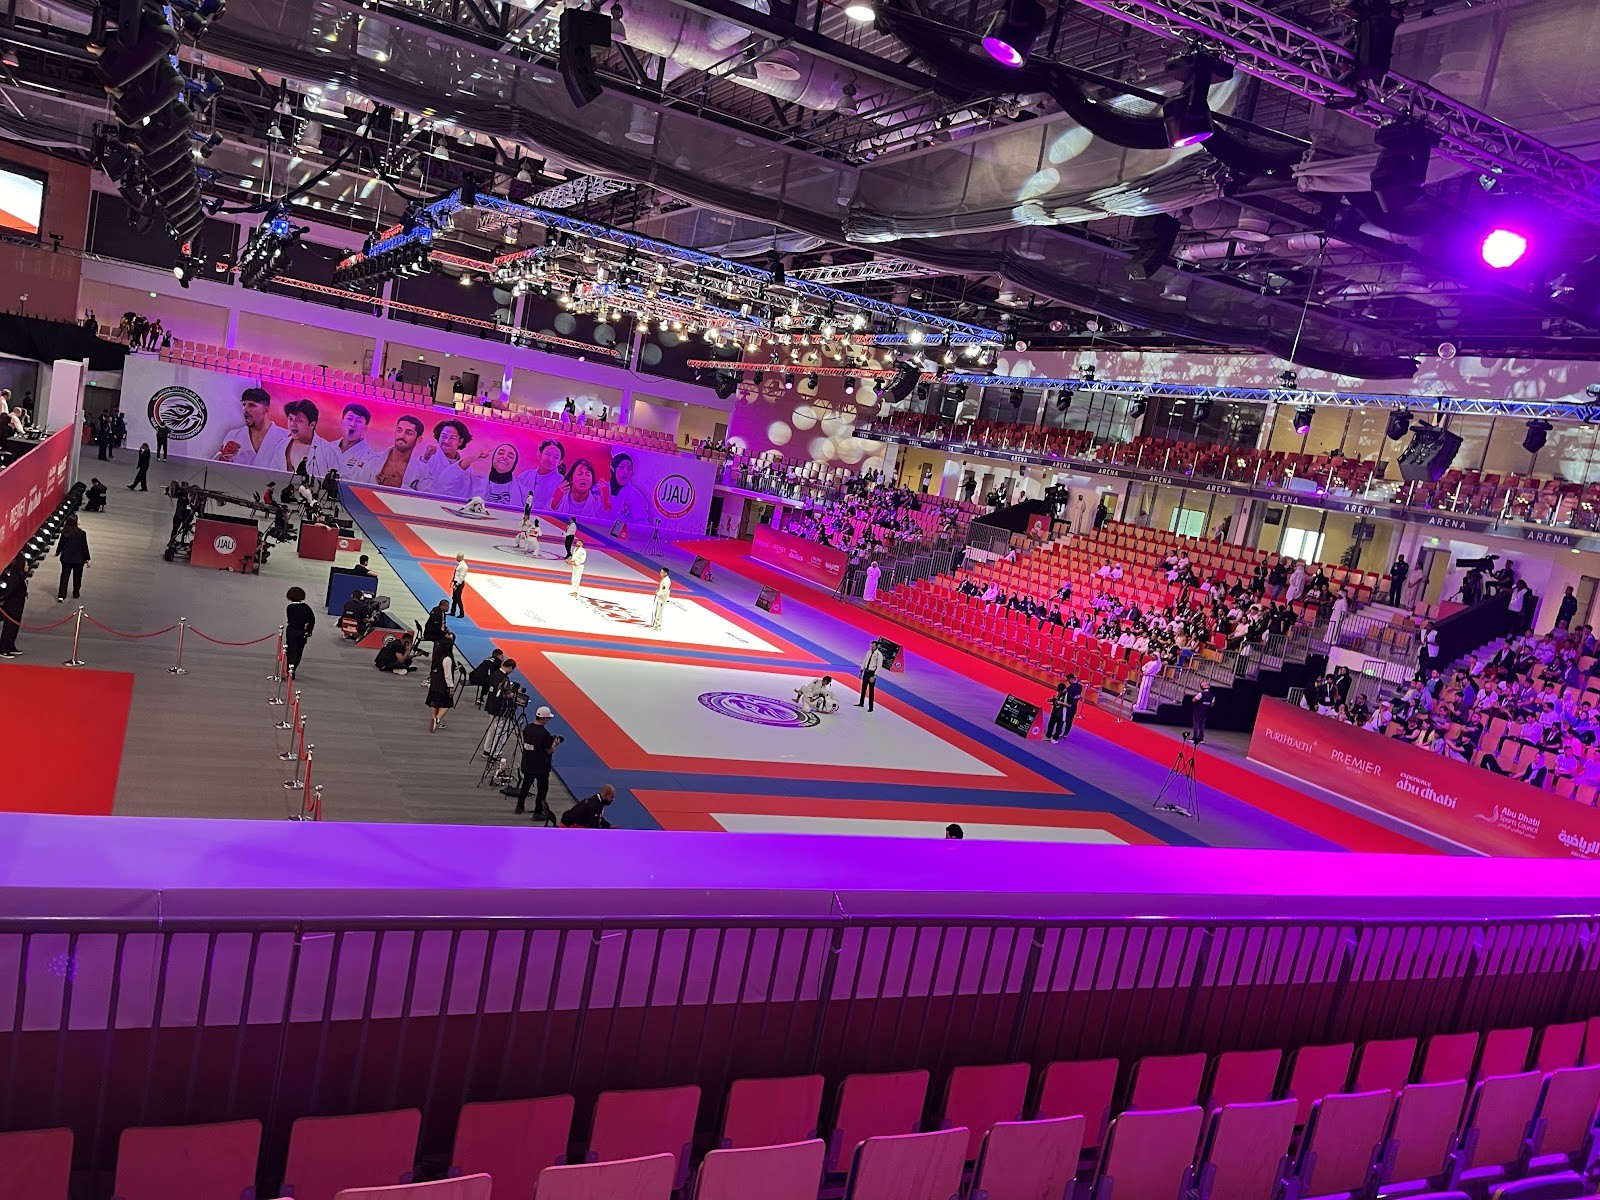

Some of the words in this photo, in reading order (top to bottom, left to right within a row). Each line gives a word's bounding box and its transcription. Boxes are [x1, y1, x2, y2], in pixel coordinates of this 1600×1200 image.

[661, 483, 690, 504] JJAU
[973, 449, 989, 457] ARENA
[1010, 455, 1028, 463] ARENA
[1052, 461, 1071, 470] ARENA
[1097, 468, 1119, 477] ARENA
[1149, 475, 1173, 485] ARENA
[1206, 484, 1232, 494] ARENA
[1270, 493, 1299, 504] ARENA
[1344, 504, 1377, 516] ARENA
[1429, 516, 1467, 530] ARENA
[1527, 530, 1570, 546] ARENA
[216, 538, 234, 550] JJAU
[1331, 749, 1382, 777] PREMIER
[1399, 772, 1432, 787] experience
[1396, 779, 1420, 796] abu
[1420, 787, 1458, 809] dhabi
[1499, 814, 1517, 826] Sports
[1517, 820, 1539, 834] Council
[1501, 806, 1517, 819] Abu
[1518, 812, 1541, 827] Dhabi
